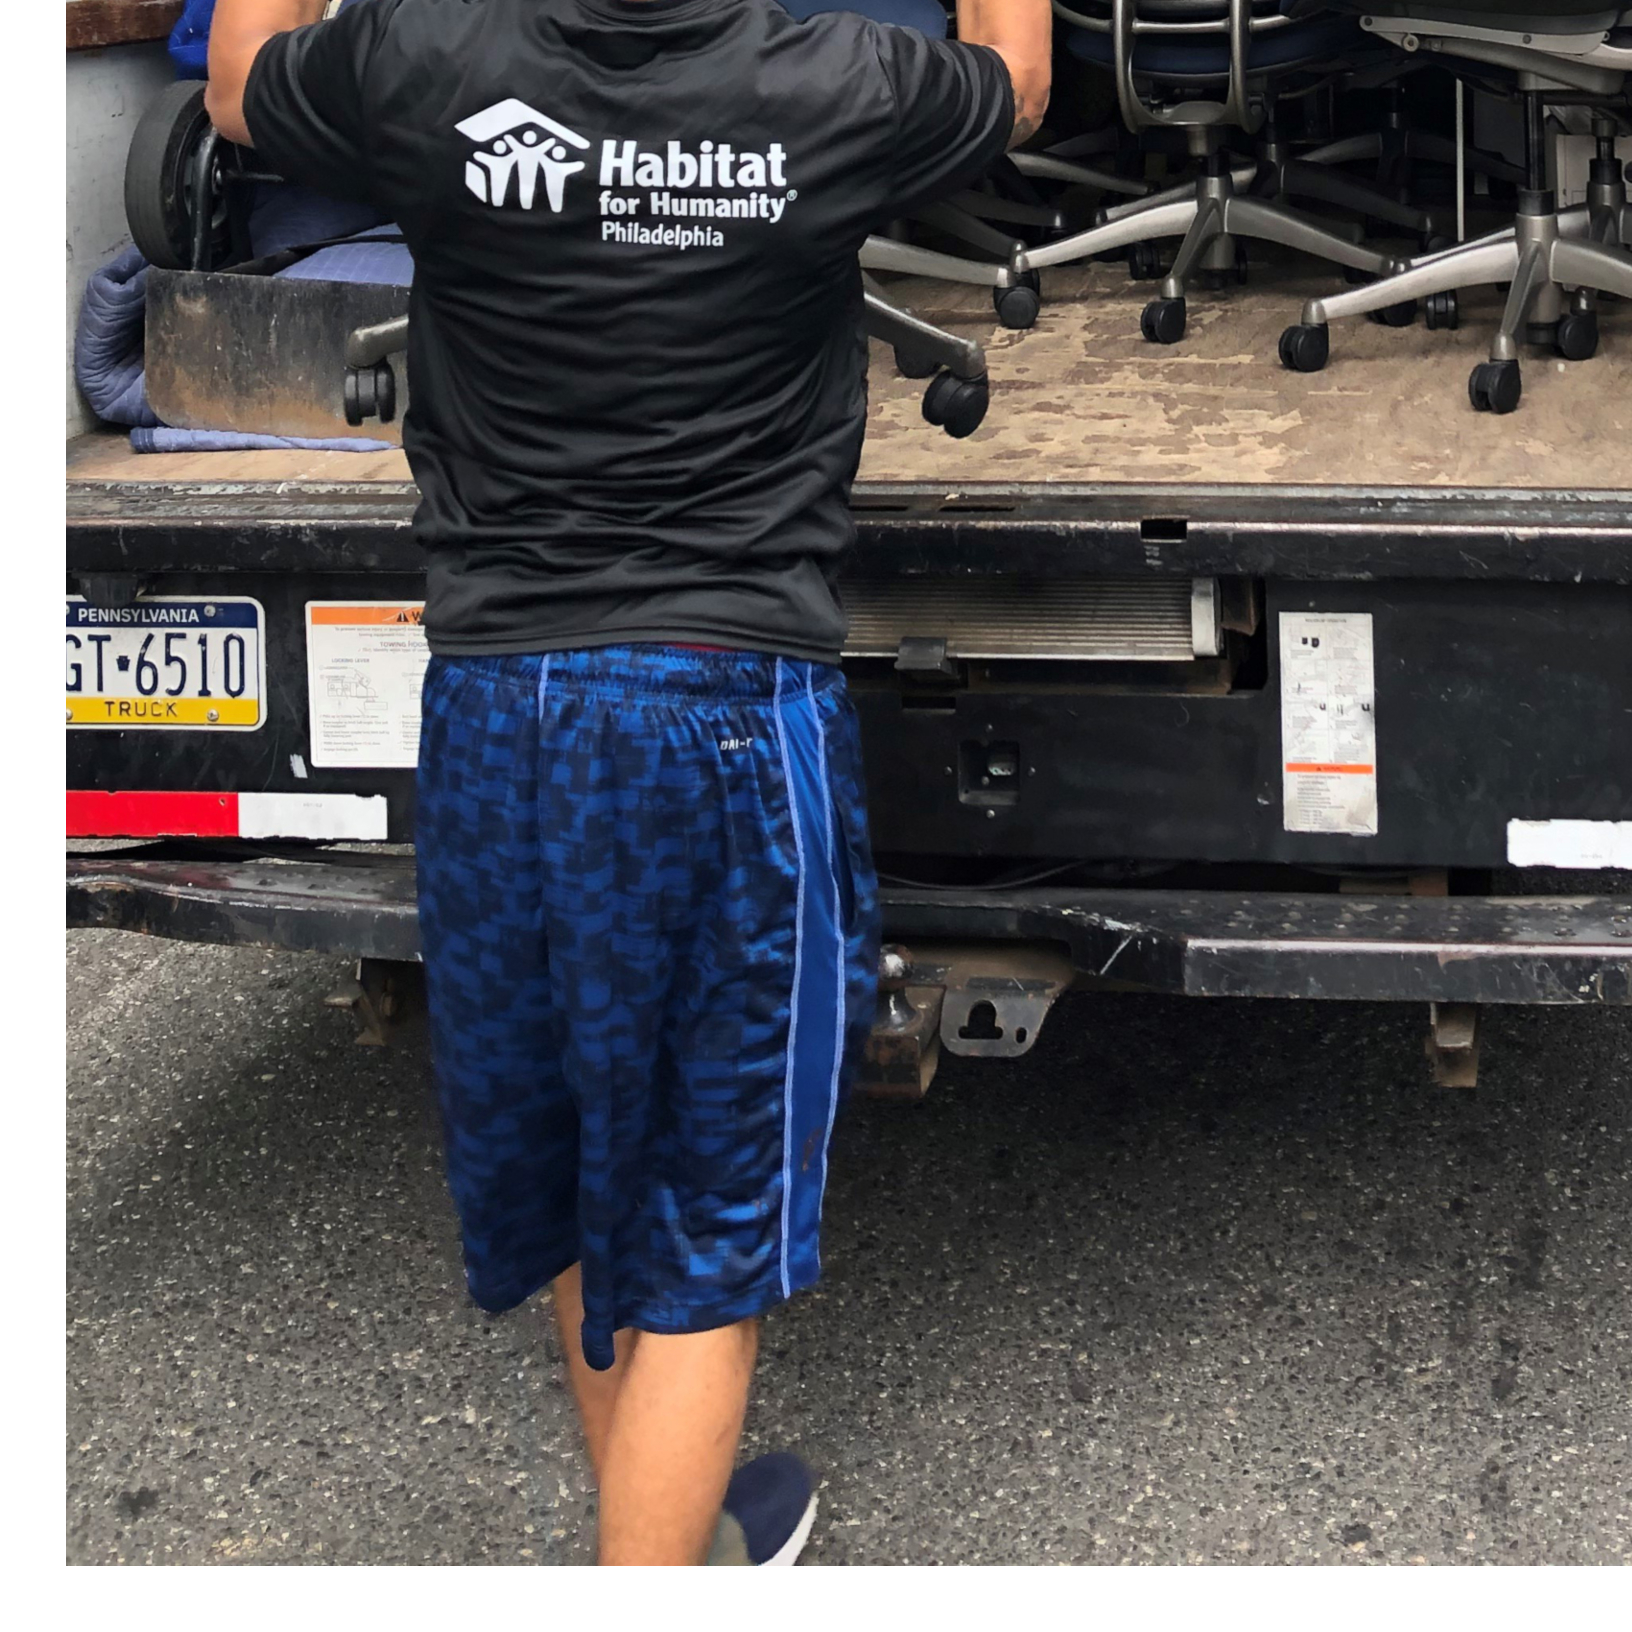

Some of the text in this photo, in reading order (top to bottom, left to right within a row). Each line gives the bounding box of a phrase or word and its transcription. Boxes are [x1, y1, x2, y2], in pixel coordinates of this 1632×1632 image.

[599, 140, 787, 188] Habitat
[599, 191, 640, 216] for
[601, 221, 724, 250] Philadelphia
[78, 608, 199, 623] PENNSYLVANIA
[104, 701, 178, 718] TRUCK
